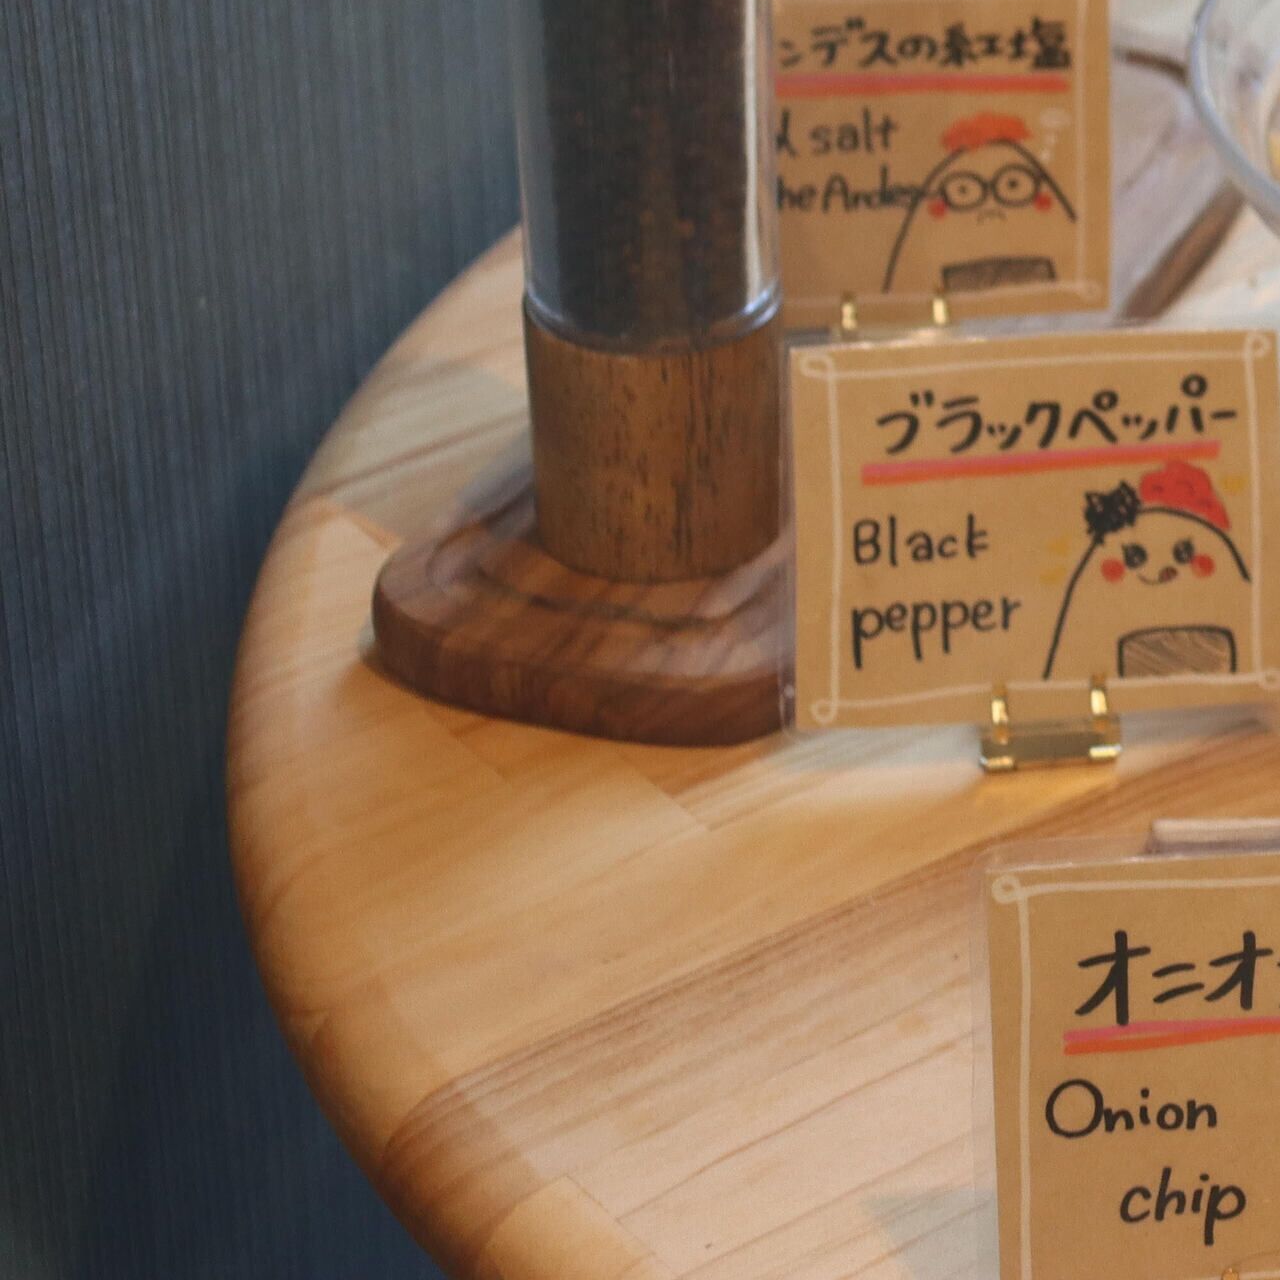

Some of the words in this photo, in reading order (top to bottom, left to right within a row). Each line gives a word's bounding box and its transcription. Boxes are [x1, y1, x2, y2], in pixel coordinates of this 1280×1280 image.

[777, 16, 1072, 70] ンデスの紅塩
[810, 106, 898, 154] salt
[875, 373, 1238, 455] ブラックペッパー
[852, 512, 991, 568] Black
[851, 596, 1022, 670] pepper
[1045, 1078, 1218, 1139] Onion
[1119, 1167, 1247, 1246] chip
